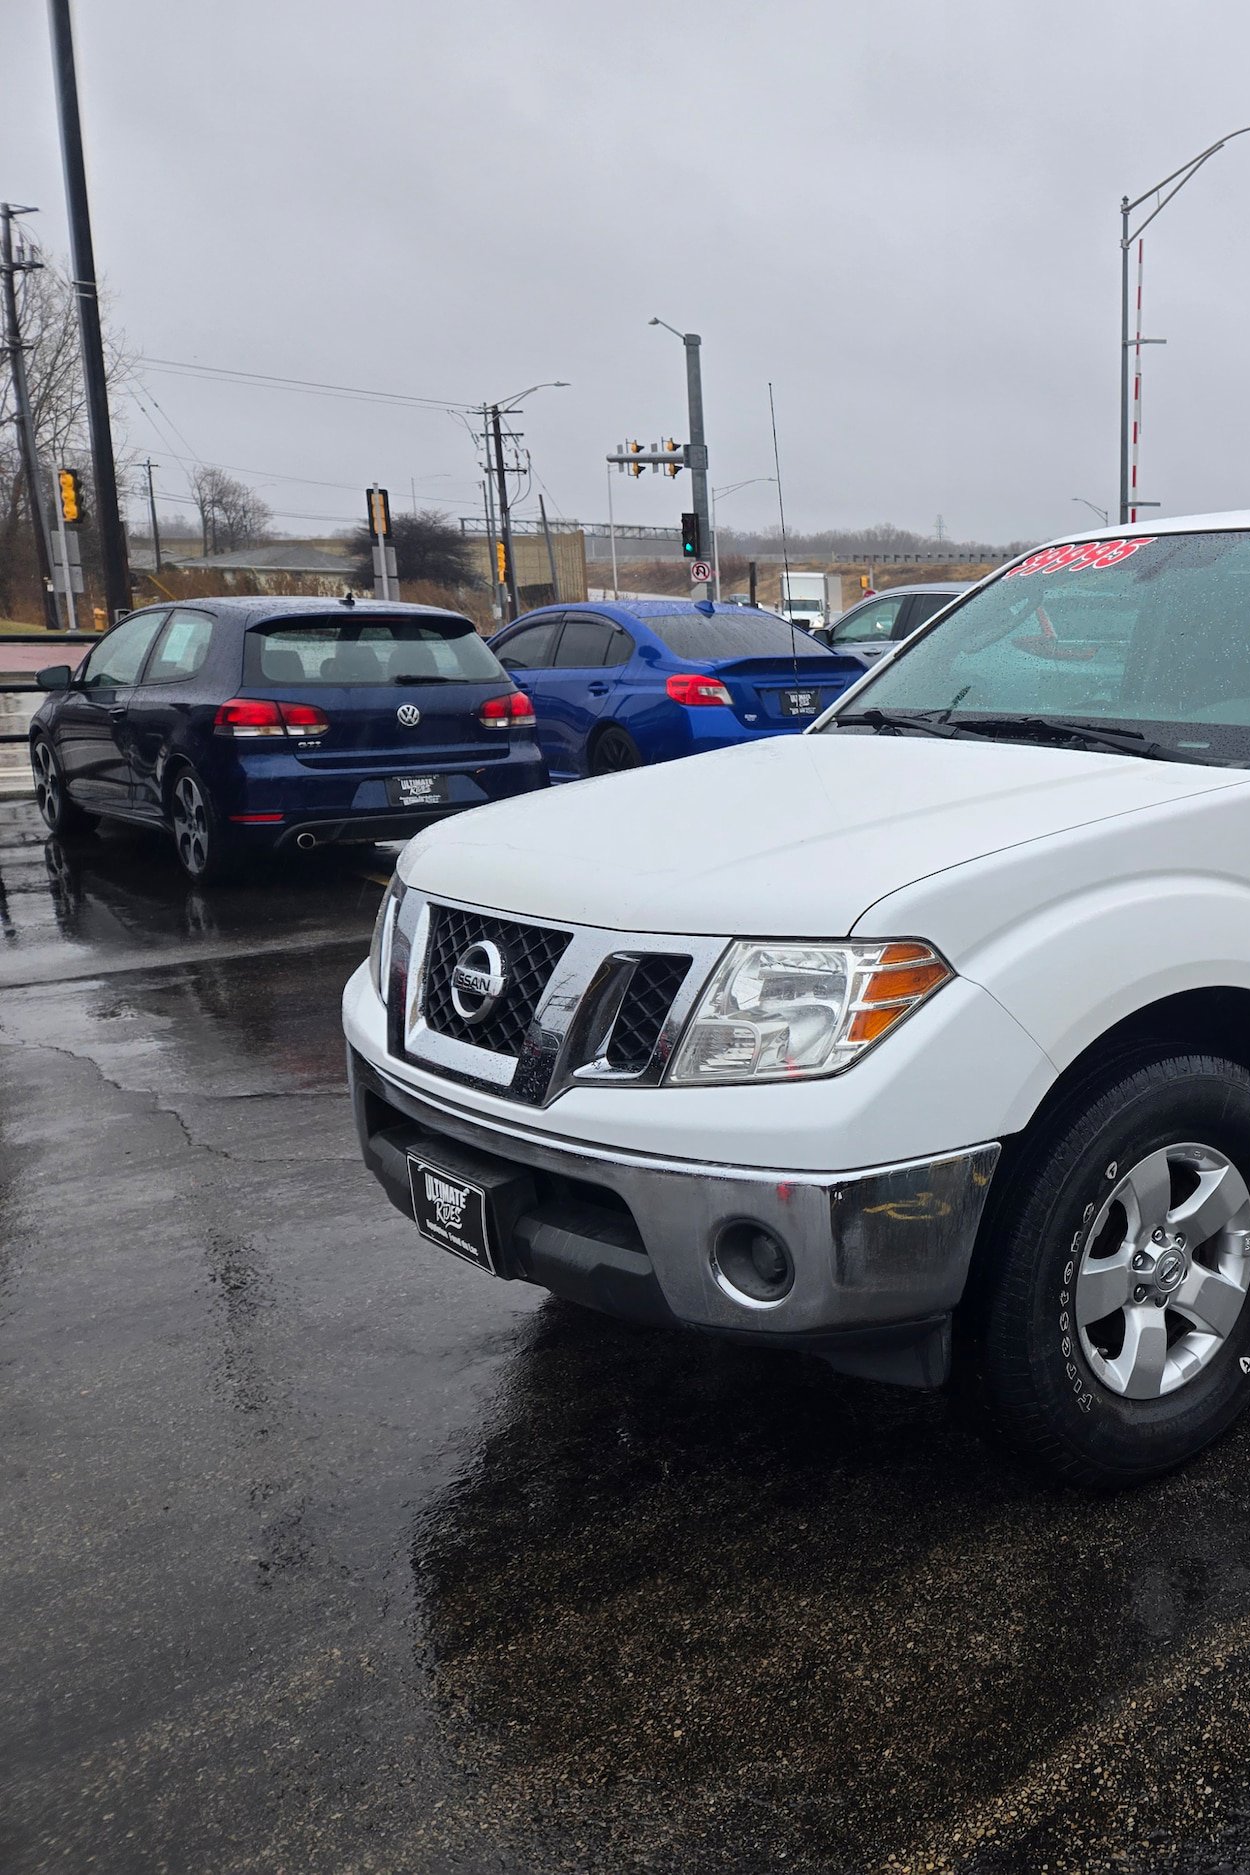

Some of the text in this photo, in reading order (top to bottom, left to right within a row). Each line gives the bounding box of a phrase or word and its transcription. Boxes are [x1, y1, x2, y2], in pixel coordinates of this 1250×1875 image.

[400, 778, 434, 790] ULTIMATE
[455, 969, 491, 992] SSAN
[424, 1172, 467, 1209] ULTIMATE
[1058, 1200, 1096, 1414] Firestone
